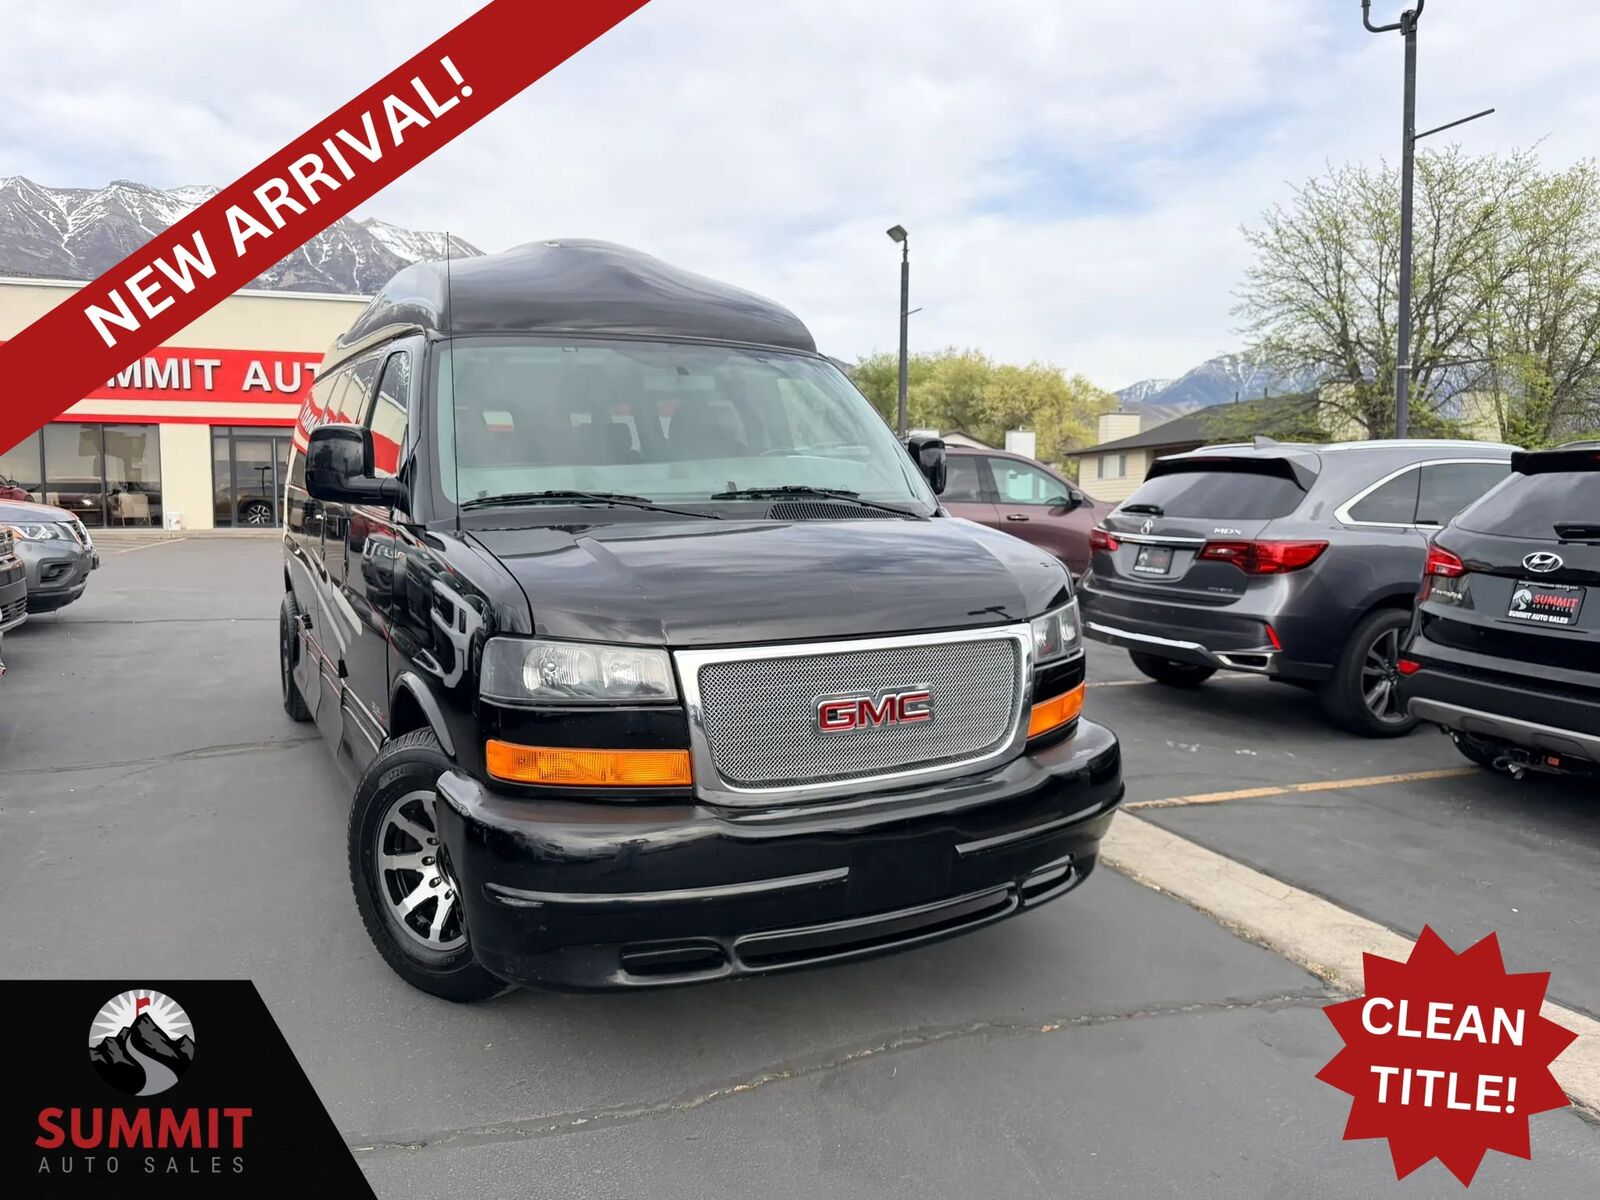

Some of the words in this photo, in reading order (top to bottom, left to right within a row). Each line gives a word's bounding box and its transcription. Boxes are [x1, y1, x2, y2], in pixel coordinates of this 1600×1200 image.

[107, 357, 221, 390] MMIT
[1214, 527, 1241, 535] MDX
[1533, 594, 1579, 608] SUMMIT
[1508, 610, 1532, 619] SUMMIT
[1531, 613, 1548, 621] AUTO
[1548, 615, 1569, 624] SALES
[816, 689, 932, 733] GMC
